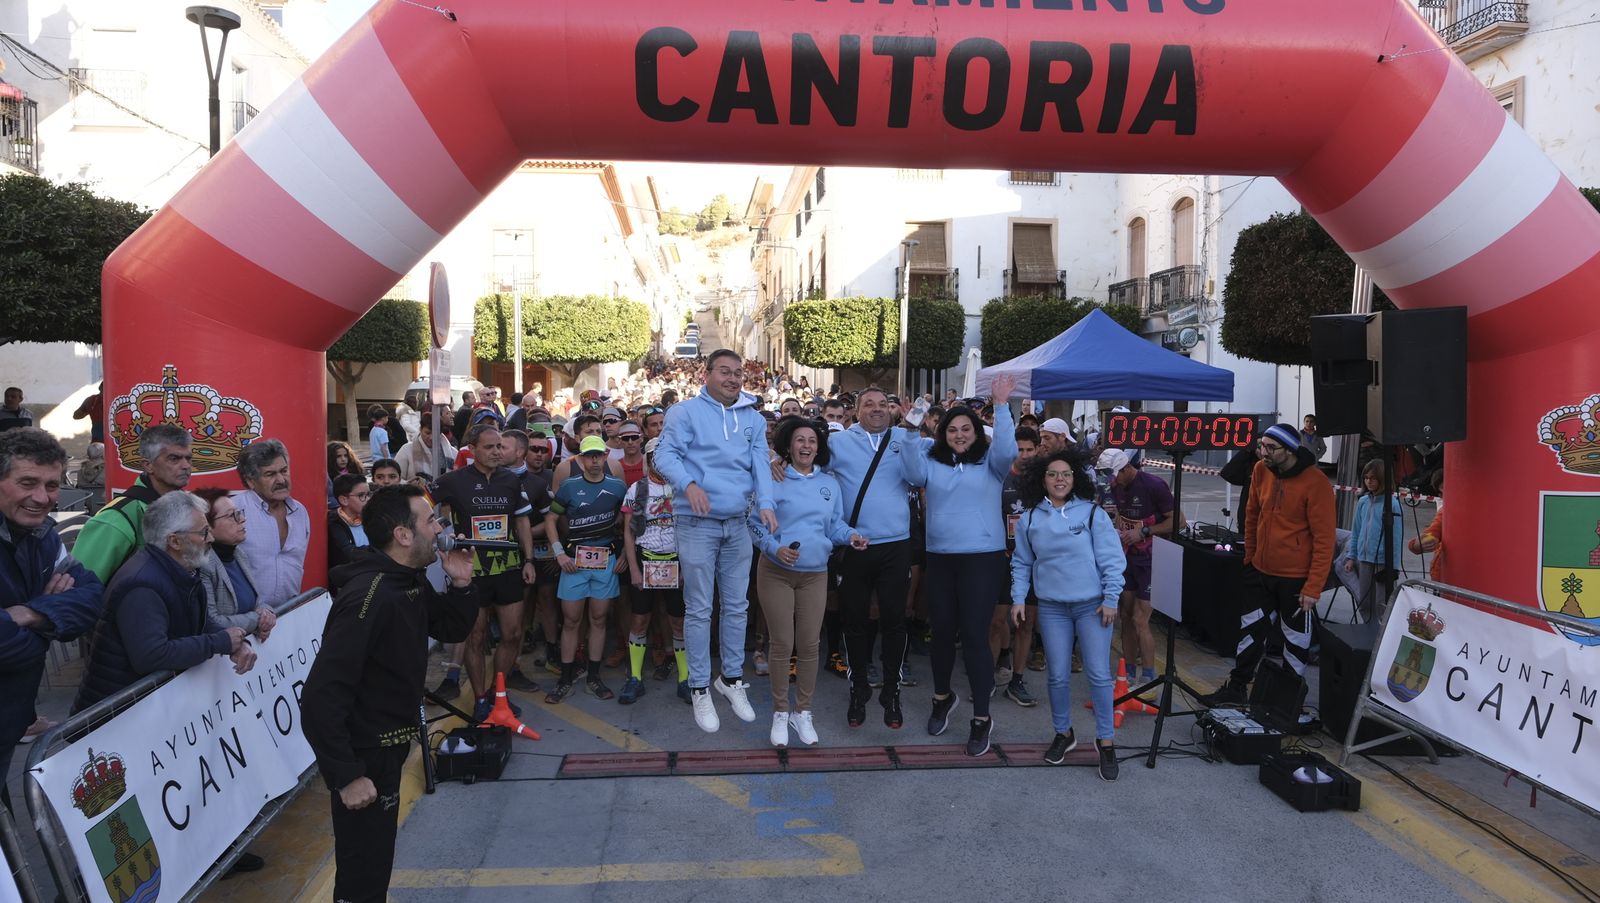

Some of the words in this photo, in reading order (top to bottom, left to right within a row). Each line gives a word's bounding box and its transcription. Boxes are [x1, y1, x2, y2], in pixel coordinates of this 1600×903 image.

[634, 26, 1198, 136] CANTORIA
[1108, 415, 1253, 447] 00:00:00
[472, 496, 509, 504] CUELLAR
[479, 522, 502, 531] 208
[585, 552, 599, 560] 31
[1457, 642, 1598, 709] AYUNTAM
[1446, 666, 1594, 754] CANT
